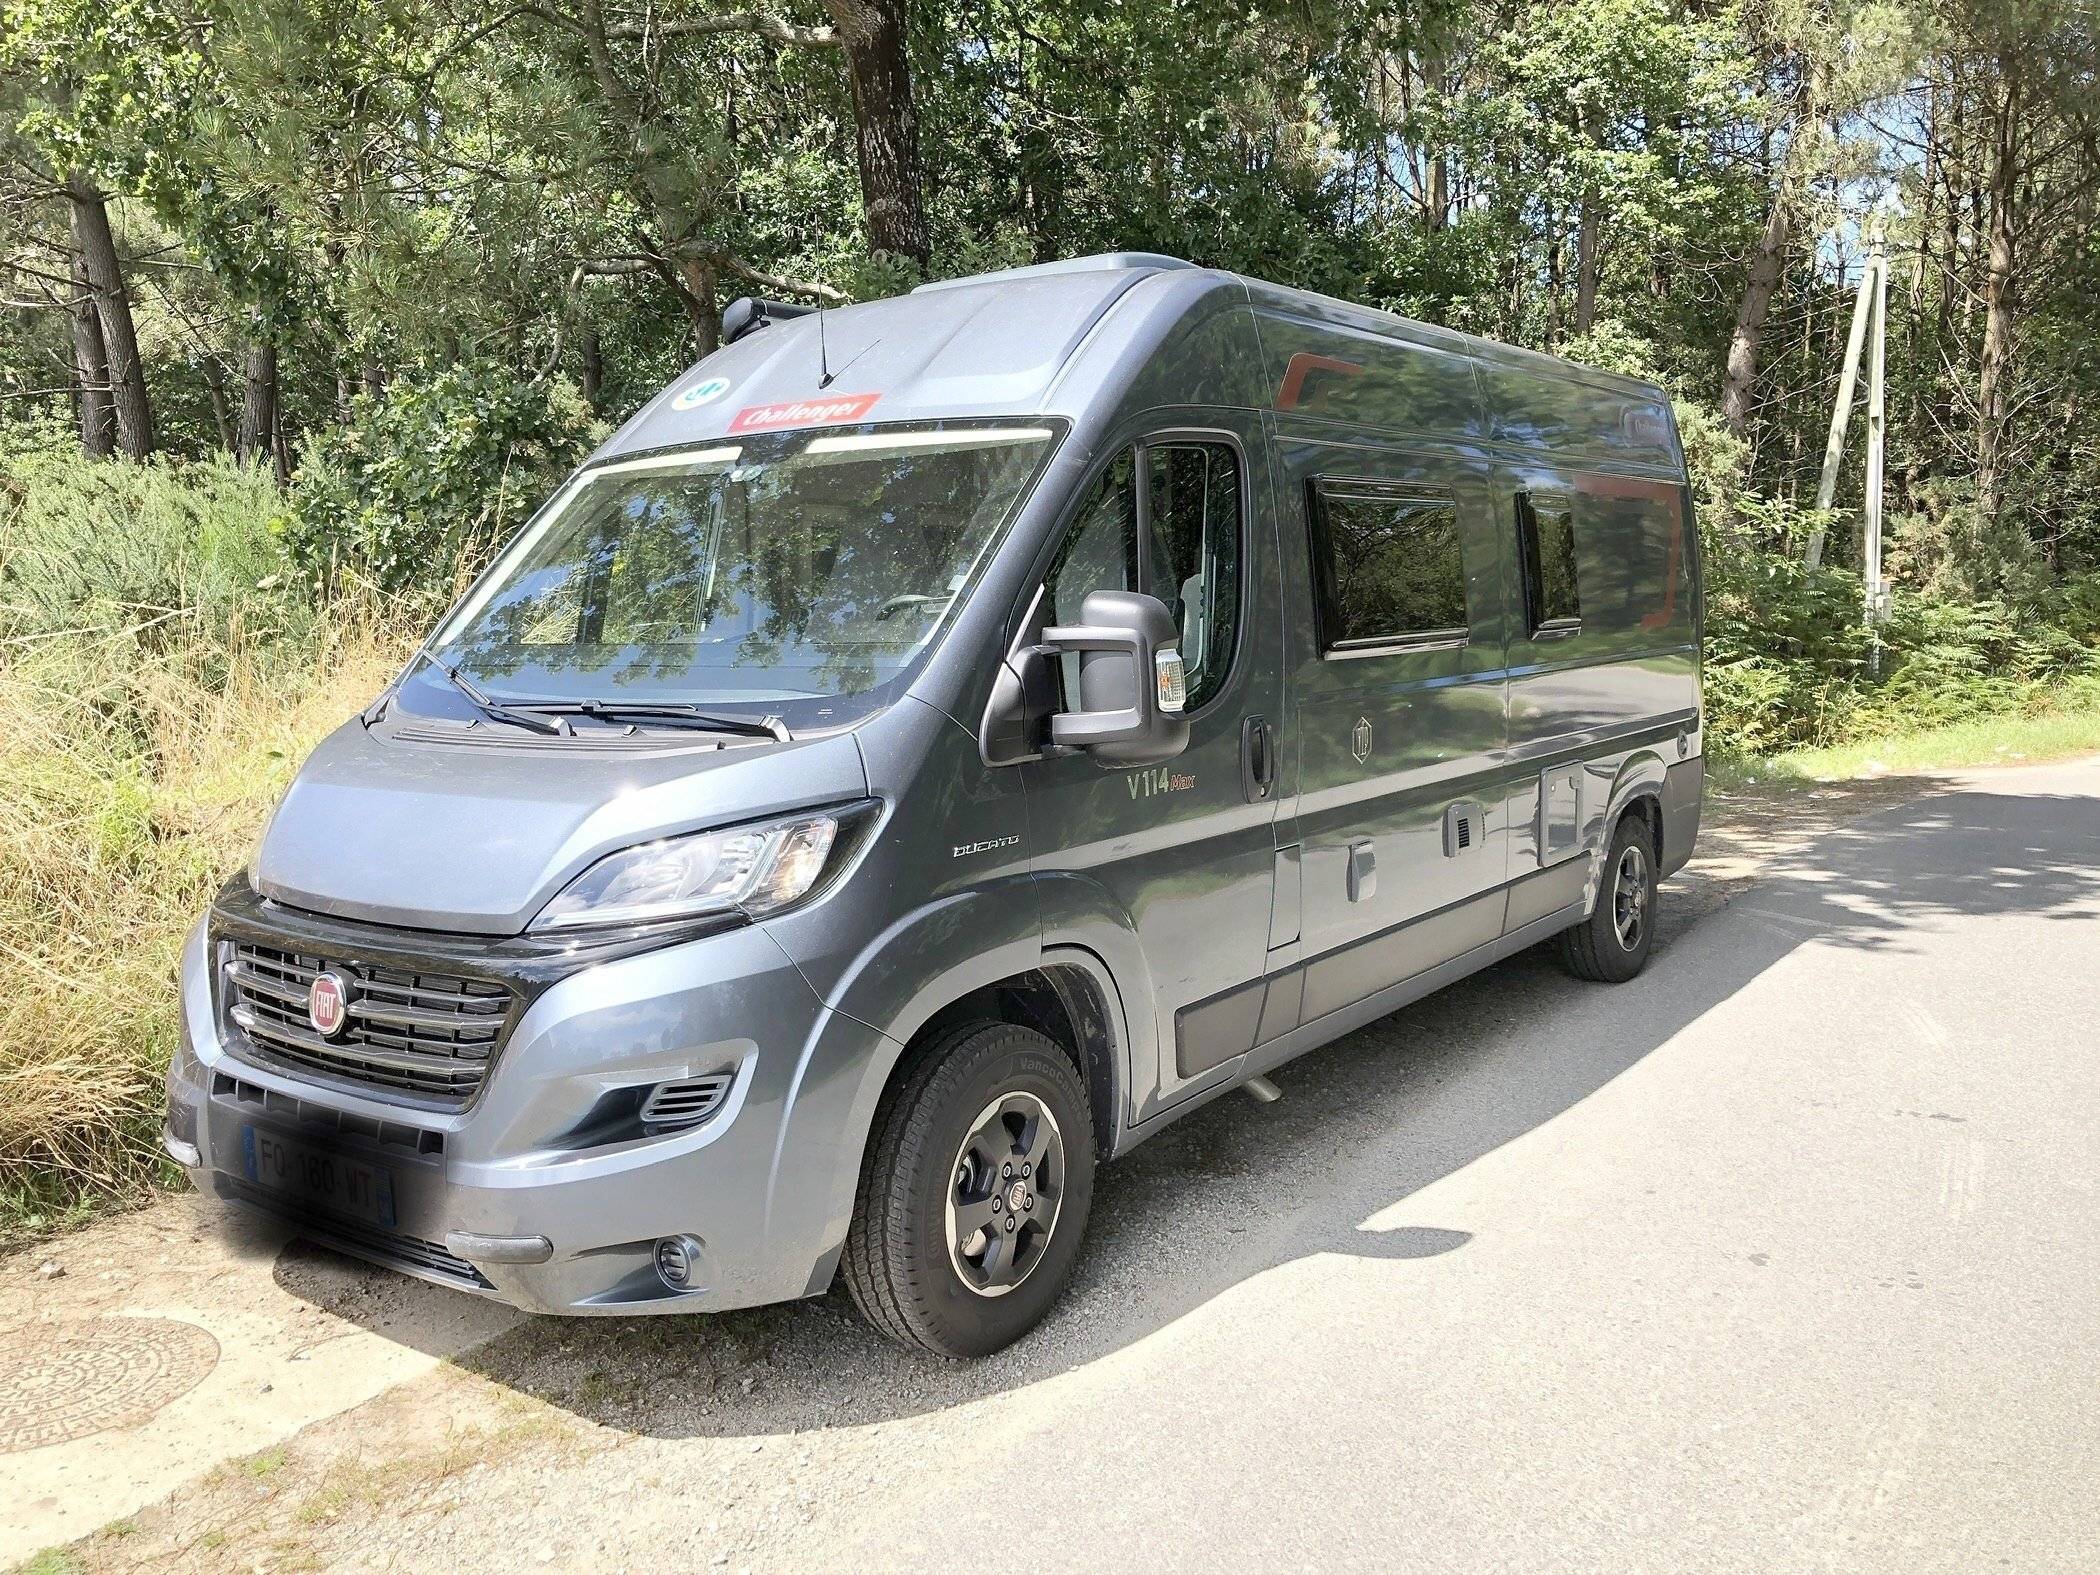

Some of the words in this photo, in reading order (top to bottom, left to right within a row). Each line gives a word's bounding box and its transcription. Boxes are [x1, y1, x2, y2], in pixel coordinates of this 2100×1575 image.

[743, 402, 864, 425] Challenger
[1126, 767, 1169, 800] V114
[1170, 774, 1196, 792] Max
[953, 835, 1020, 858] DUCATO
[316, 990, 337, 1019] FIAT
